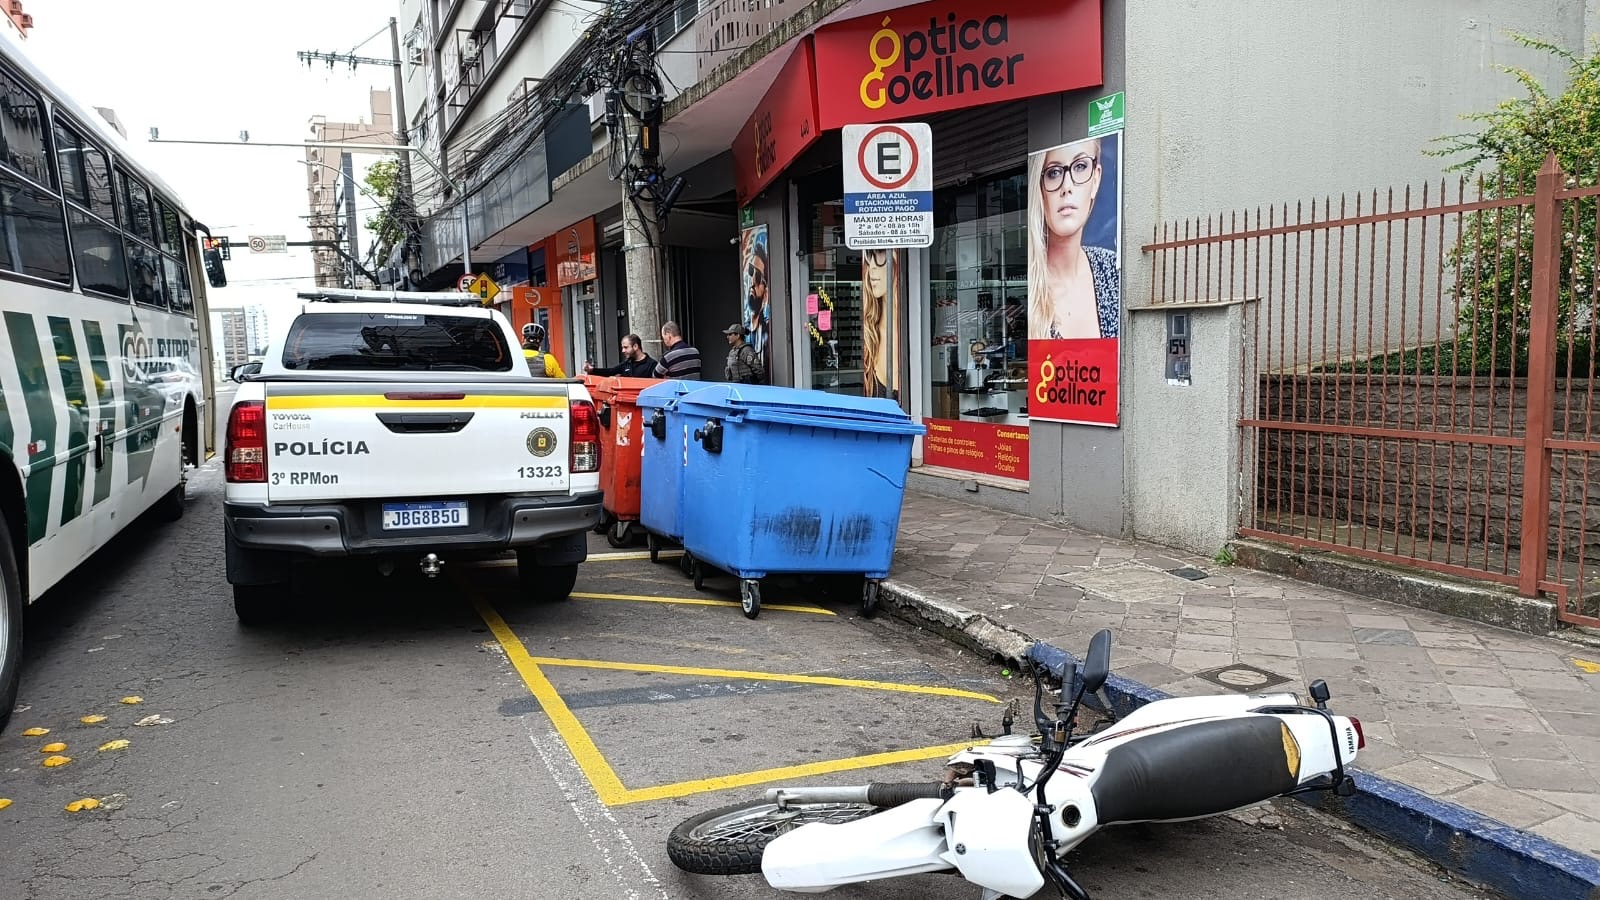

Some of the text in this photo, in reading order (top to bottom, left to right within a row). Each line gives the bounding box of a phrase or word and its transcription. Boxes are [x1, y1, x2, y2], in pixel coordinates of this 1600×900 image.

[868, 12, 1008, 72] Óptica
[860, 53, 1024, 109] Goellner
[877, 142, 901, 175] E
[855, 199, 919, 207] ESTACIONAMENTO
[853, 215, 887, 223] MÁXIMO
[895, 214, 924, 222] HORAS
[252, 240, 264, 248] 50
[1041, 354, 1101, 387] Óptica
[1035, 381, 1107, 406] Goellner
[272, 413, 312, 421] TOYOTA
[520, 411, 564, 419] HILUX
[272, 422, 311, 430] CarHouse
[274, 438, 370, 457] POLÍCIA
[958, 447, 965, 455] de
[290, 471, 339, 485] RPMon
[517, 465, 562, 479] 13323
[392, 509, 460, 526] JBG8B50
[1345, 727, 1355, 754] YAMAHA
